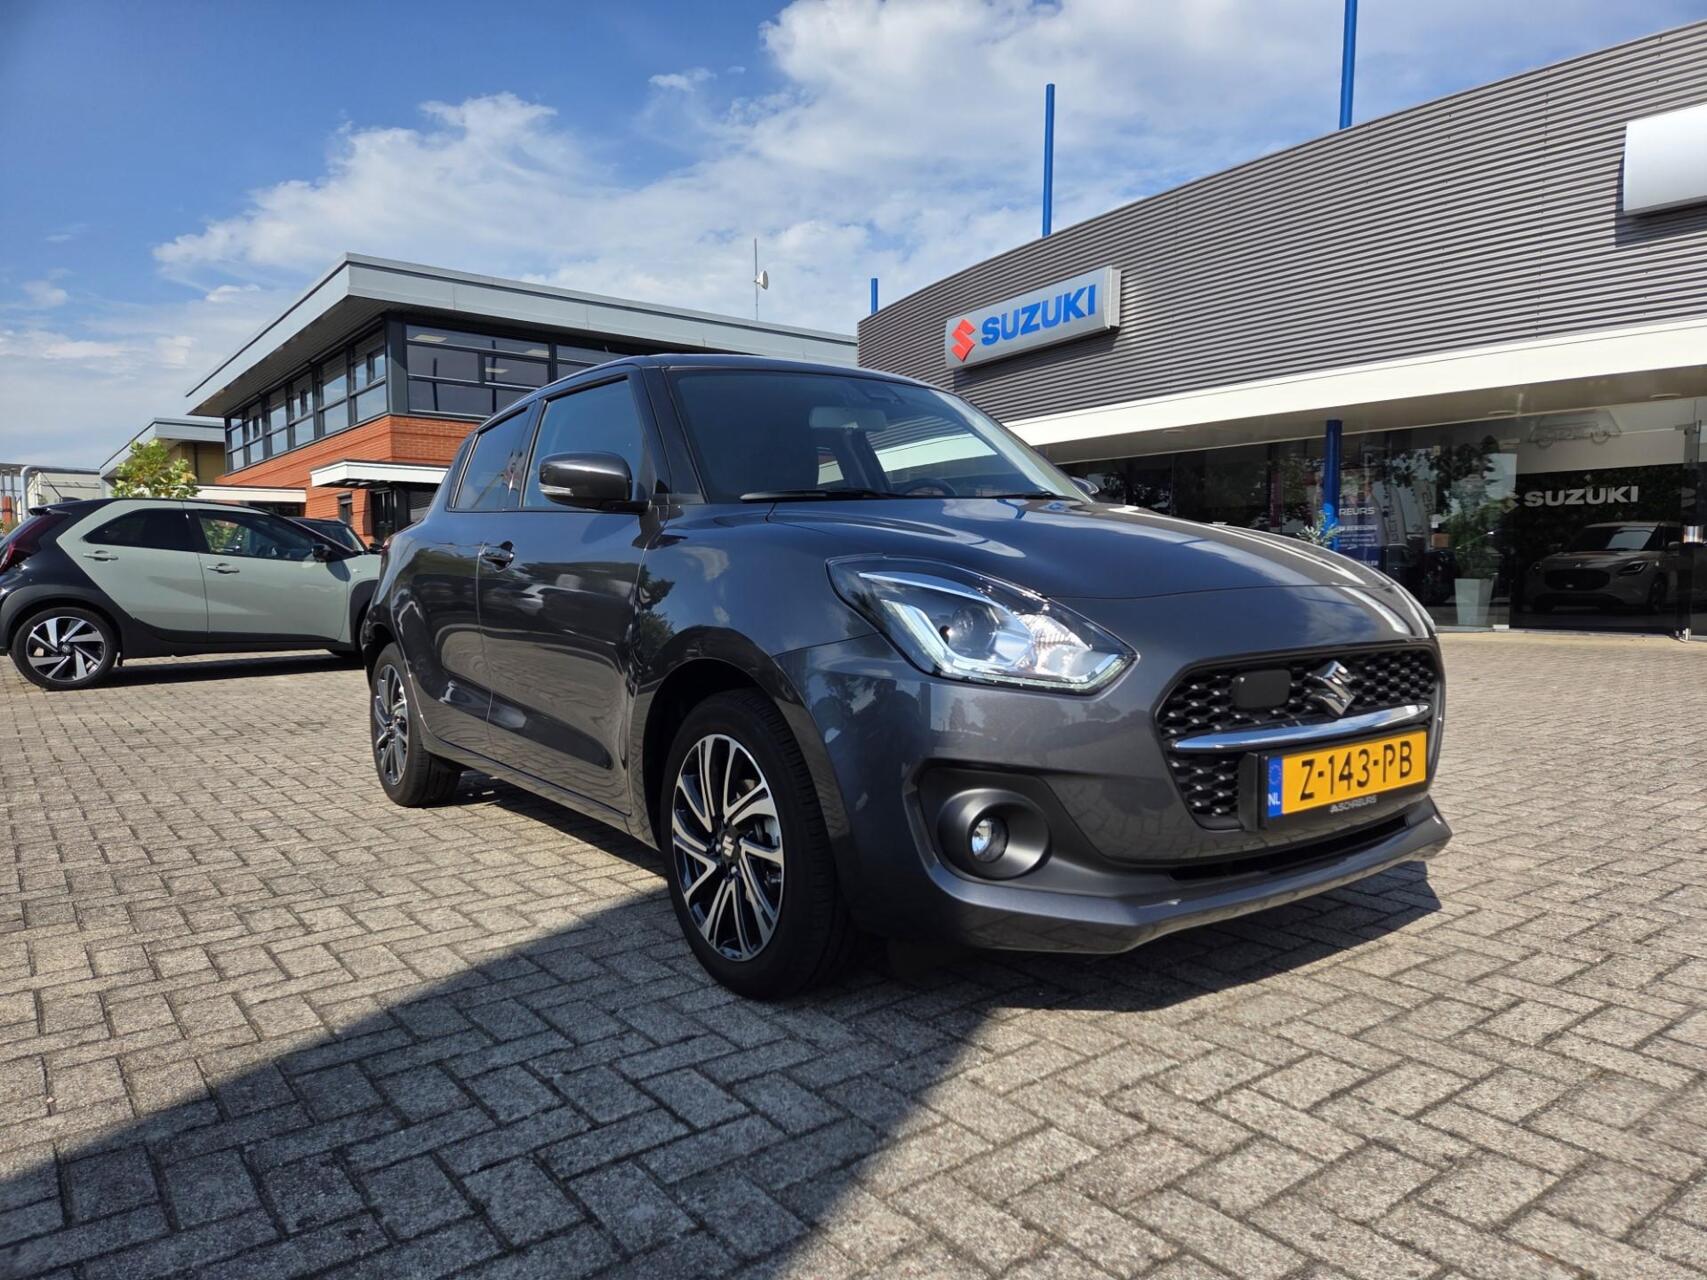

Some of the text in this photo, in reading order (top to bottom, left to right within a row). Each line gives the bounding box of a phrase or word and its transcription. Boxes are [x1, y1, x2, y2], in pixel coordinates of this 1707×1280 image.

[981, 284, 1096, 346] SUZUKI
[1524, 486, 1639, 507] SUZUKI
[1300, 740, 1413, 801] Z-143-PB
[1267, 792, 1281, 807] NL
